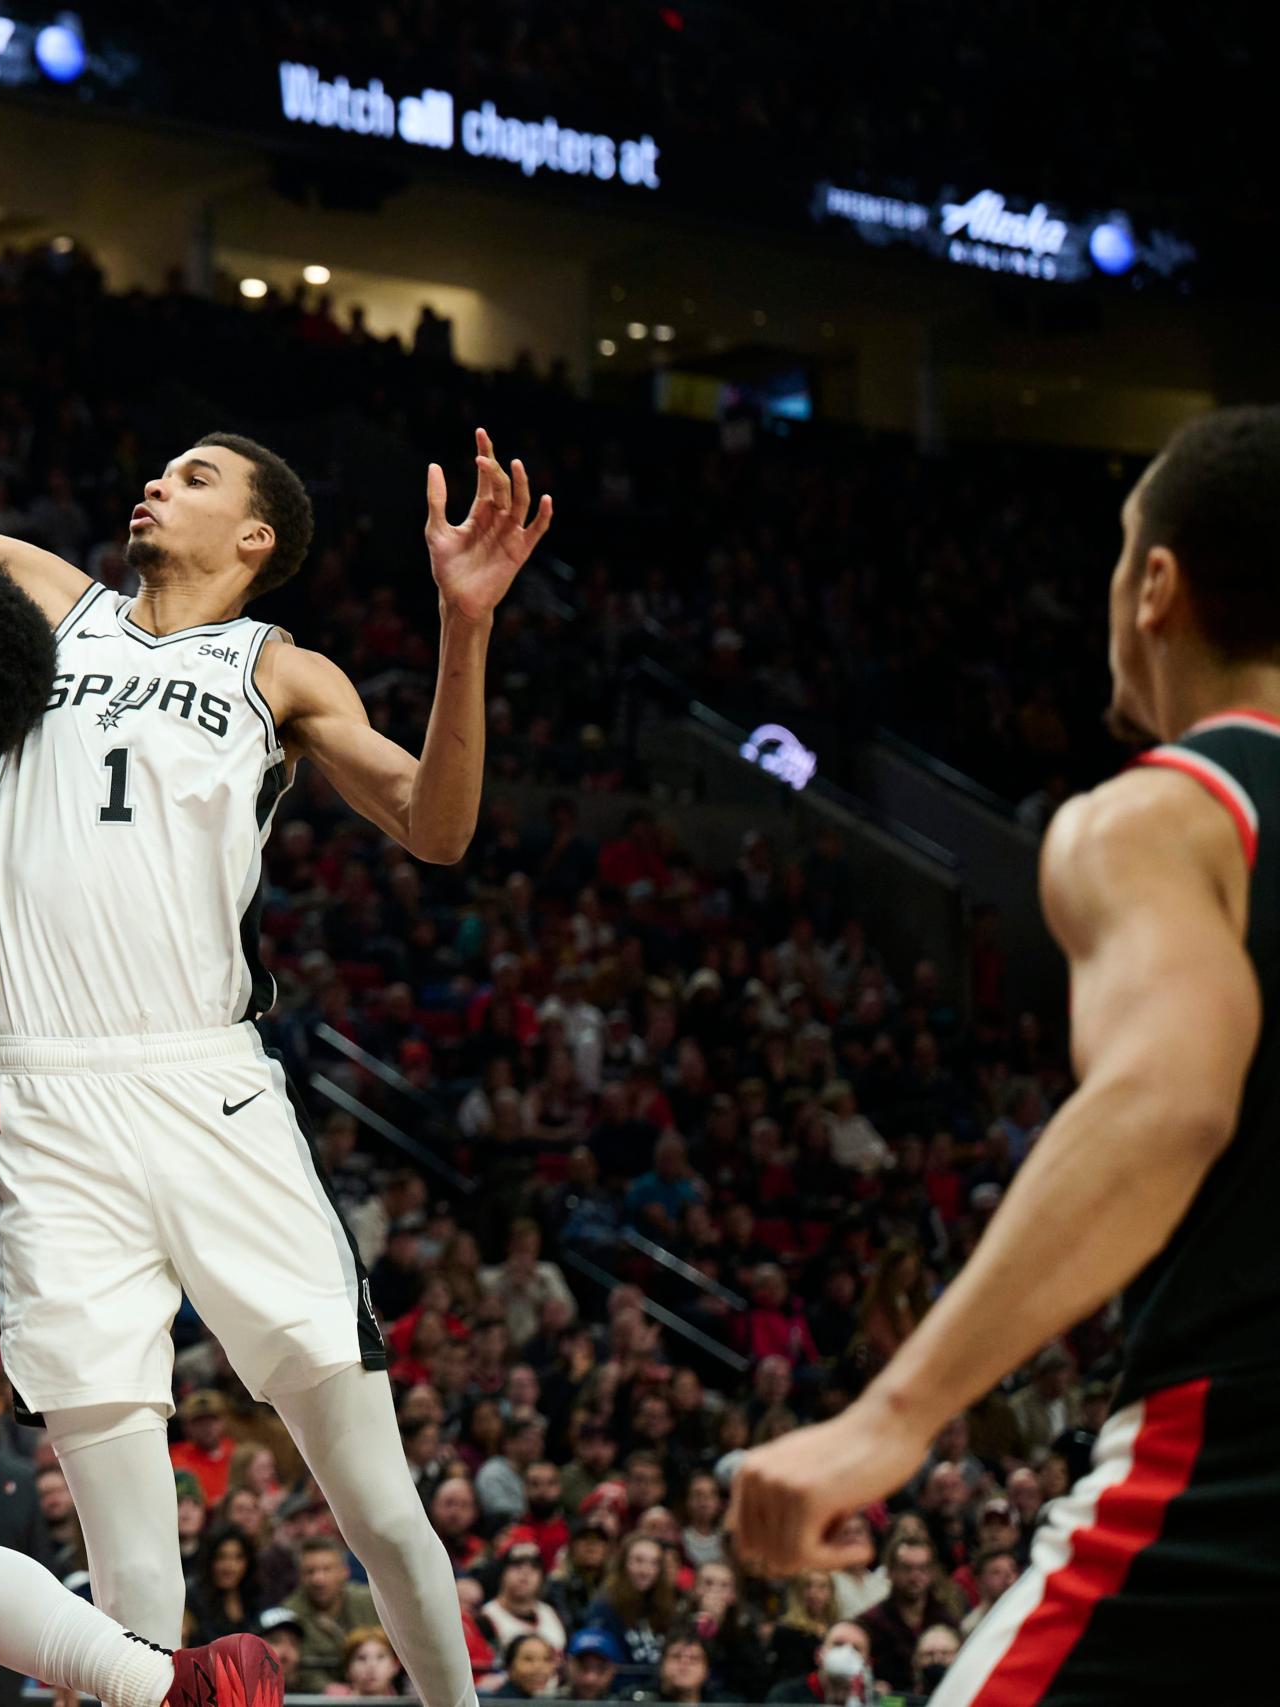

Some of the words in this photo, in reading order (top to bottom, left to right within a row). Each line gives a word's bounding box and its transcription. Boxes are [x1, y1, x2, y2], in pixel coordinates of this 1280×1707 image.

[280, 62, 395, 138] Watch
[398, 88, 454, 149] all
[462, 101, 616, 180] chapters
[620, 134, 660, 189] at
[45, 674, 232, 738] SPURS
[98, 747, 132, 822] 1
